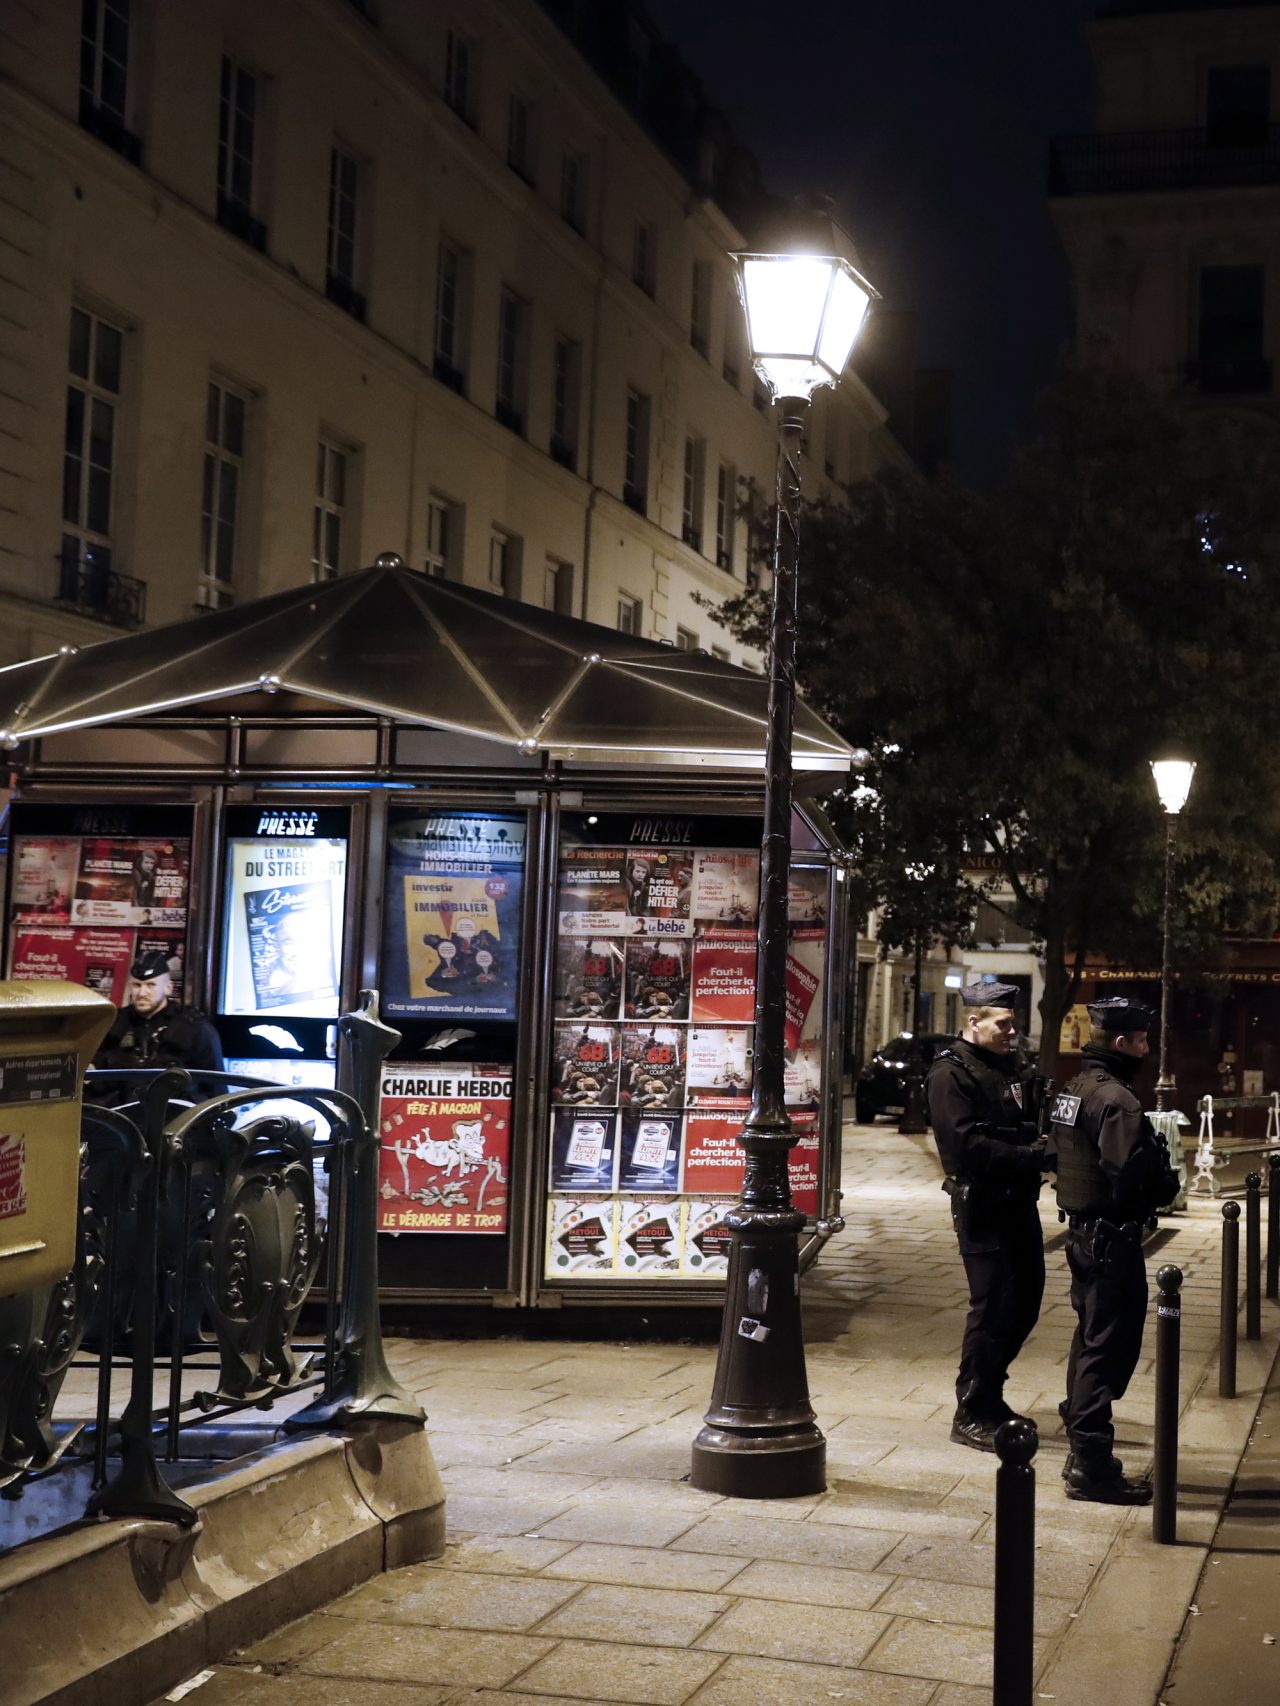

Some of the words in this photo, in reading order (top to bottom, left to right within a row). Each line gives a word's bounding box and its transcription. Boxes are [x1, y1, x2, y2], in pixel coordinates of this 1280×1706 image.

[257, 811, 318, 836] PRESSE
[425, 818, 491, 837] PRESSE
[630, 820, 691, 842] PRESSE
[264, 848, 274, 859] LE
[578, 850, 625, 859] Recherche
[113, 860, 134, 870] MARS
[245, 861, 263, 877] DU
[268, 861, 312, 876] STREET
[420, 862, 493, 873] IMMOBILIER
[567, 869, 598, 879] PLANÈTE
[599, 871, 620, 879] MARS
[153, 886, 183, 898] HITLER
[412, 882, 453, 892] investir
[649, 884, 679, 896] DÉFIER
[415, 902, 488, 912] IMMOBILIER
[648, 897, 678, 908] HITLER
[657, 919, 686, 932] bébé
[696, 941, 758, 953] philosophie
[27, 952, 59, 962] Faut-il
[15, 962, 55, 971] chercher
[56, 963, 67, 971] la
[584, 959, 609, 976] 68
[651, 959, 676, 976] 68
[710, 968, 743, 976] Faut-il
[697, 977, 741, 986] chercher
[744, 977, 754, 986] la
[695, 986, 756, 997] perfection?
[388, 1003, 405, 1011] Chez
[406, 1004, 426, 1012] votre
[427, 1005, 463, 1013] marchand
[473, 1006, 507, 1014] journaux
[579, 1044, 605, 1061] 68
[647, 1047, 672, 1064] 68
[382, 1079, 452, 1096] CHARLIE
[457, 1081, 512, 1098] HEBDO
[407, 1101, 429, 1115] FÊTE
[428, 1101, 438, 1115] À
[439, 1102, 481, 1115] MACRON
[689, 1110, 748, 1123] philosophi
[703, 1138, 736, 1147] Faut-il
[690, 1148, 734, 1157] chercher
[736, 1148, 746, 1157] la
[810, 1172, 817, 1181] la
[382, 1213, 396, 1227] LE
[399, 1210, 452, 1227] DÉRAPAGE
[456, 1213, 470, 1227] DE
[473, 1214, 502, 1227] TROP
